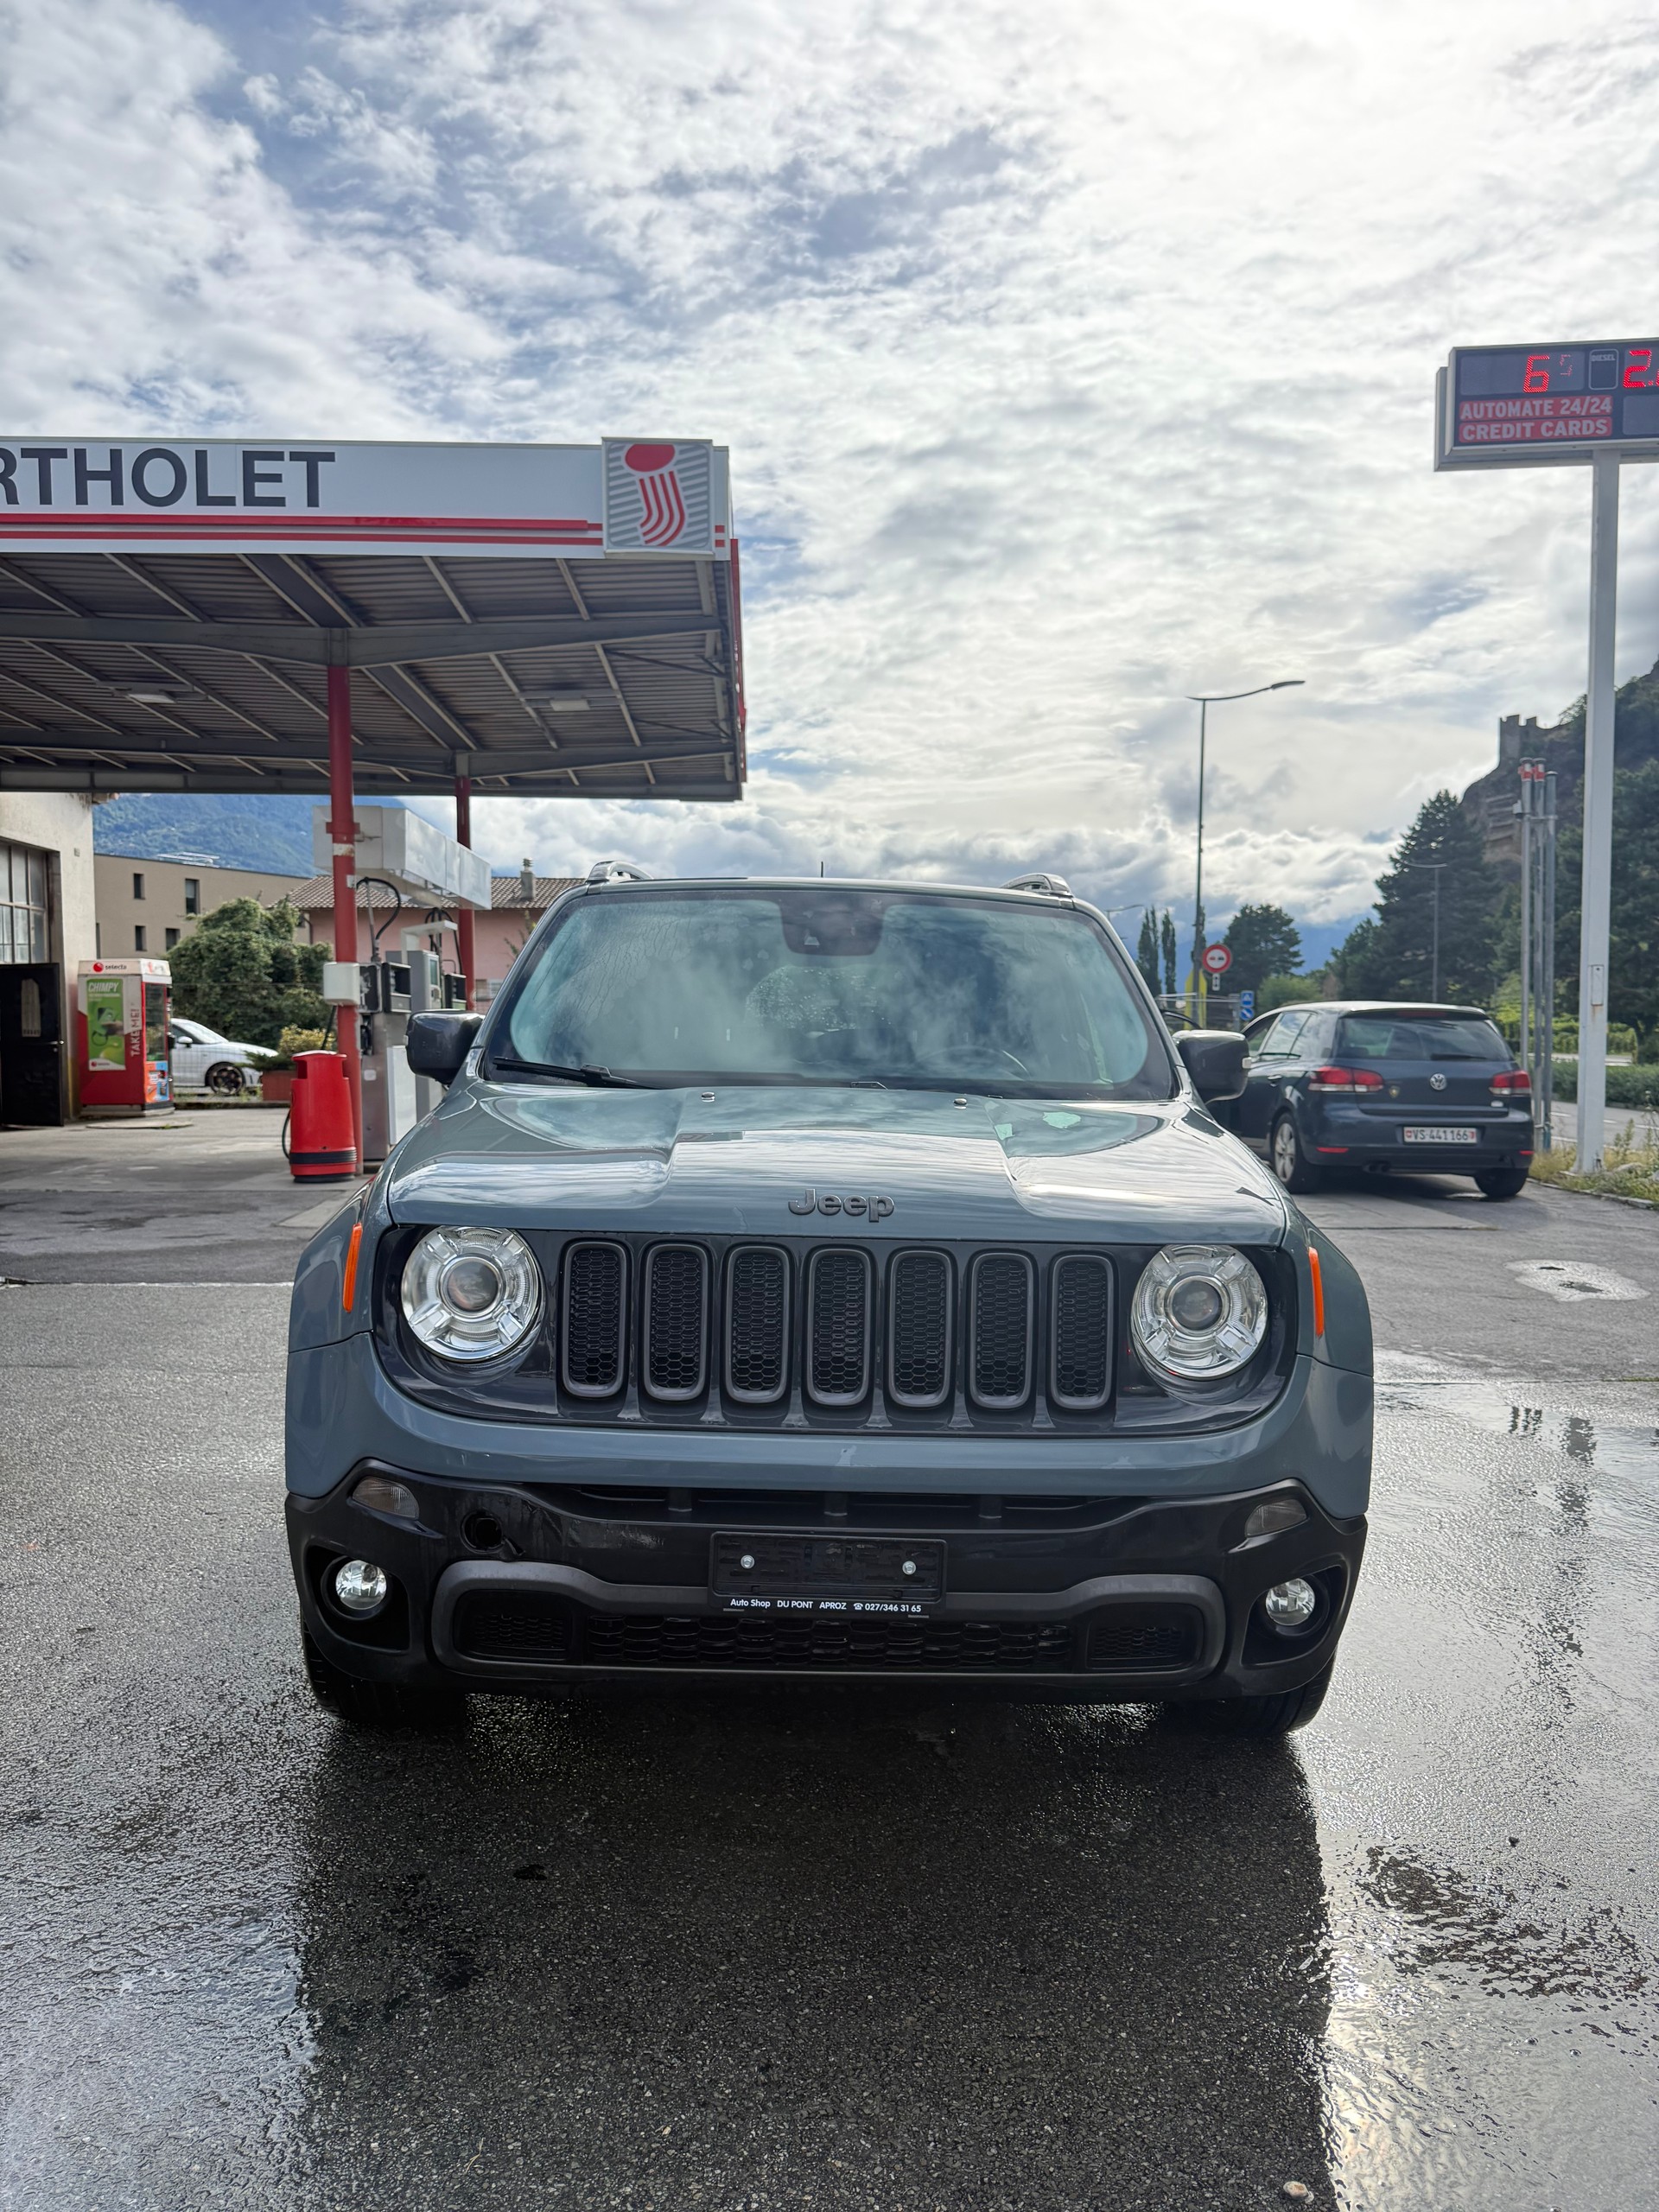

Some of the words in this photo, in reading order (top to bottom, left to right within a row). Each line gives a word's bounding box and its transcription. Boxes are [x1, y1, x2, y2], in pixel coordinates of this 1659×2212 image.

[1623, 348, 1659, 389] 2.
[1460, 399, 1554, 420] AUTOMATE
[1560, 395, 1613, 416] 24/24
[1462, 422, 1535, 441] CREDIT
[1540, 418, 1607, 437] CARDS
[88, 982, 119, 993] CHIMPY
[130, 1008, 140, 1028] ME!
[130, 1030, 140, 1057] TAKE
[788, 1188, 895, 1224] Jeep
[730, 1599, 749, 1607] Auto
[750, 1599, 771, 1609] Shop
[777, 1599, 790, 1608] DU
[791, 1600, 813, 1609] PONT
[819, 1601, 847, 1610] APROZ
[865, 1603, 899, 1611] 027/346
[900, 1604, 909, 1612] 31
[911, 1605, 921, 1613] 65
